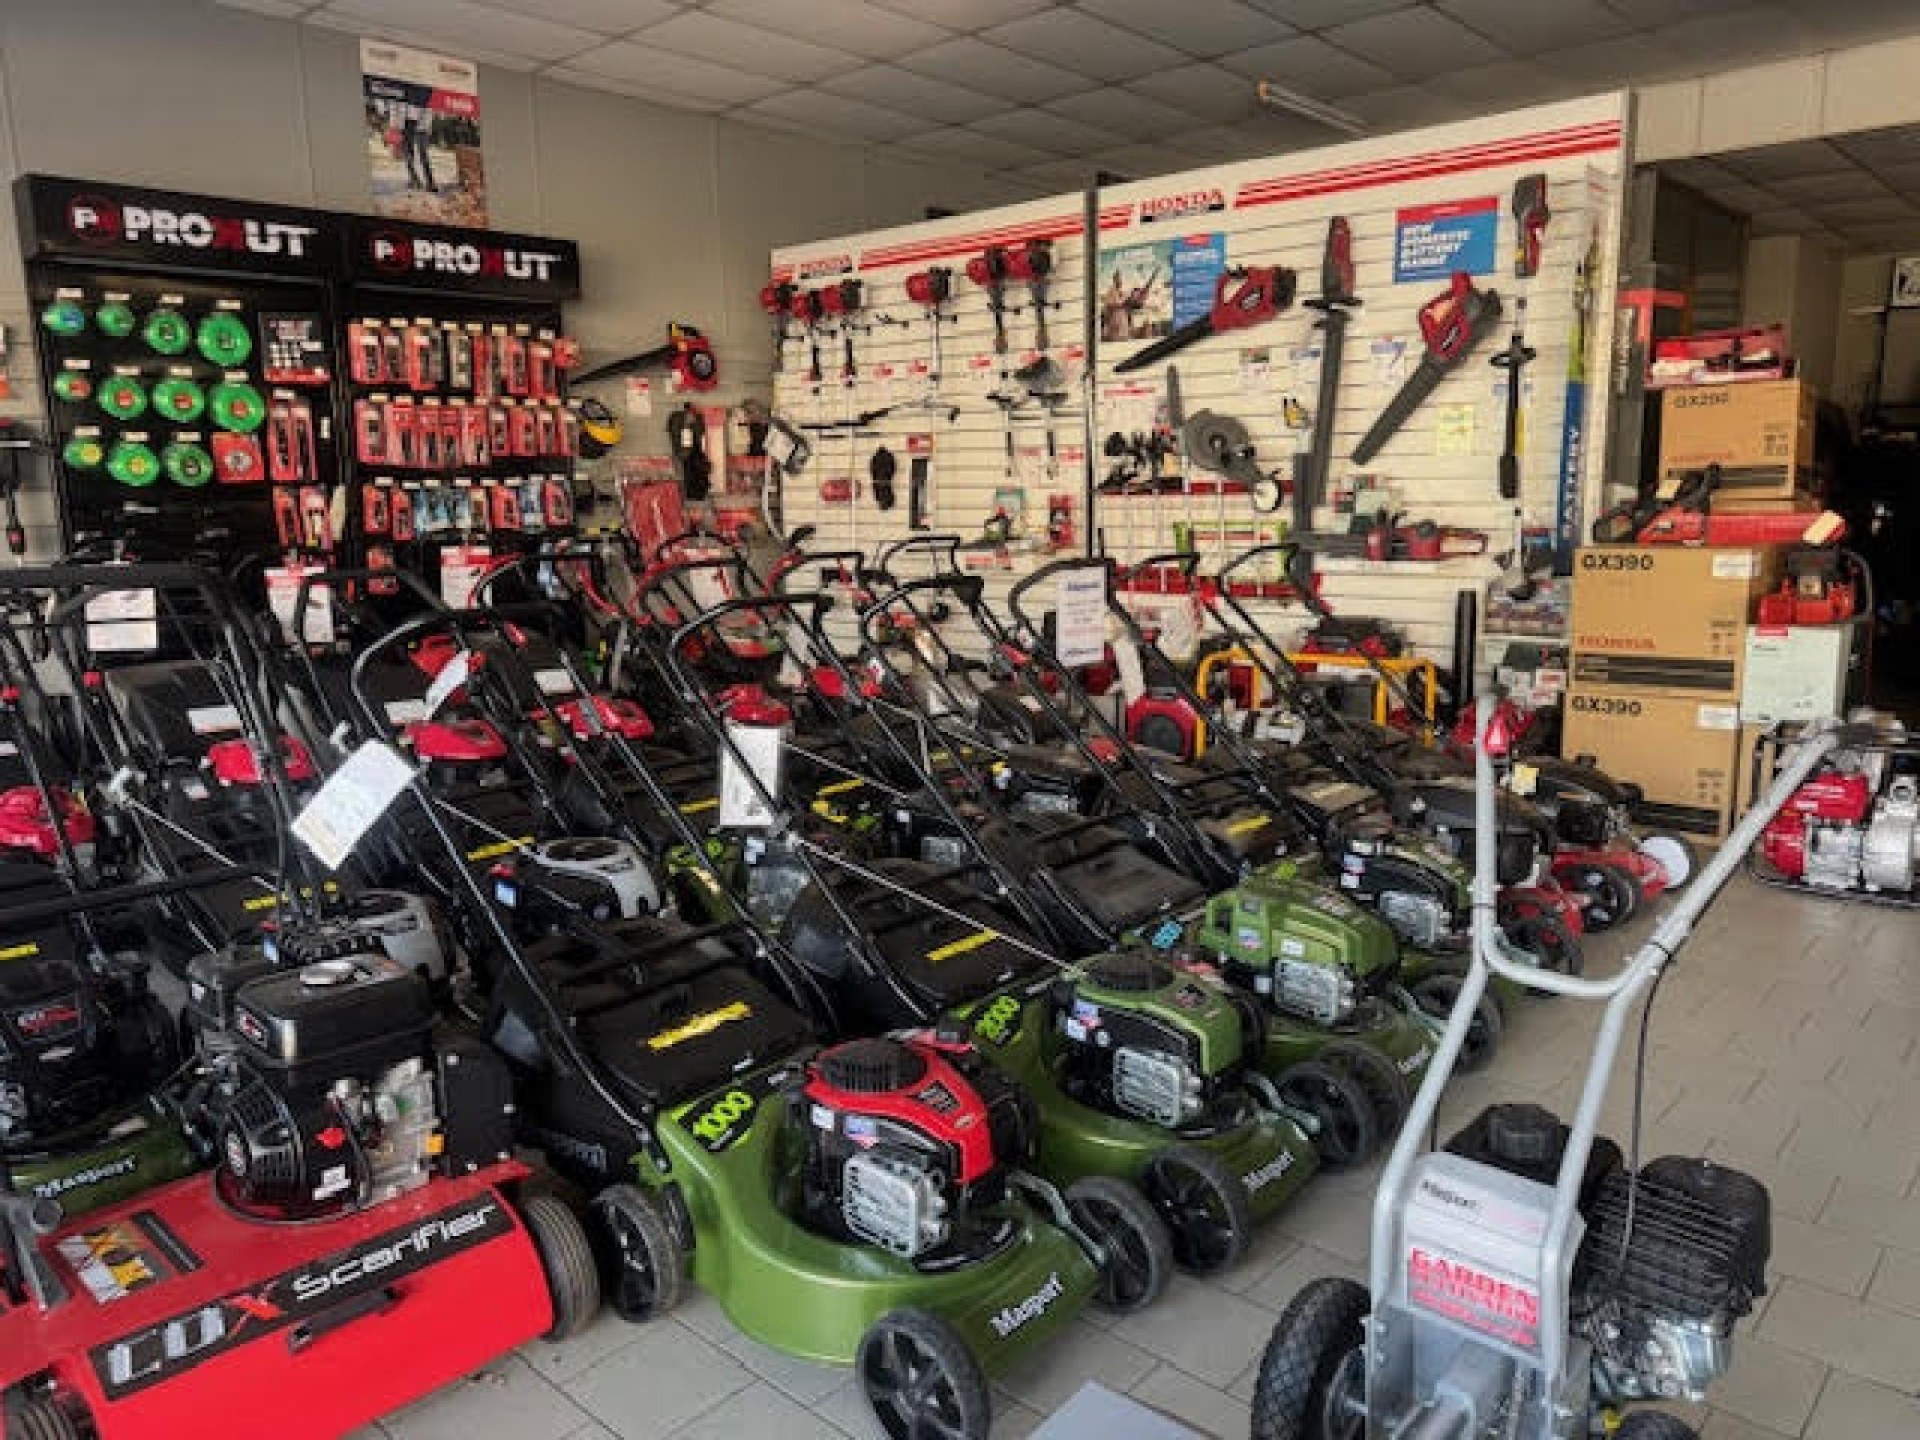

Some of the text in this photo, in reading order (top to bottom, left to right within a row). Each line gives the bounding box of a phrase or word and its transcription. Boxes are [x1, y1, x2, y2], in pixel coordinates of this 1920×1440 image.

[1141, 187, 1224, 214] HONDA
[1582, 554, 1655, 571] GX390
[1571, 696, 1643, 717] GX390
[693, 1090, 754, 1142] 1000
[292, 1203, 498, 1302] Scarifier
